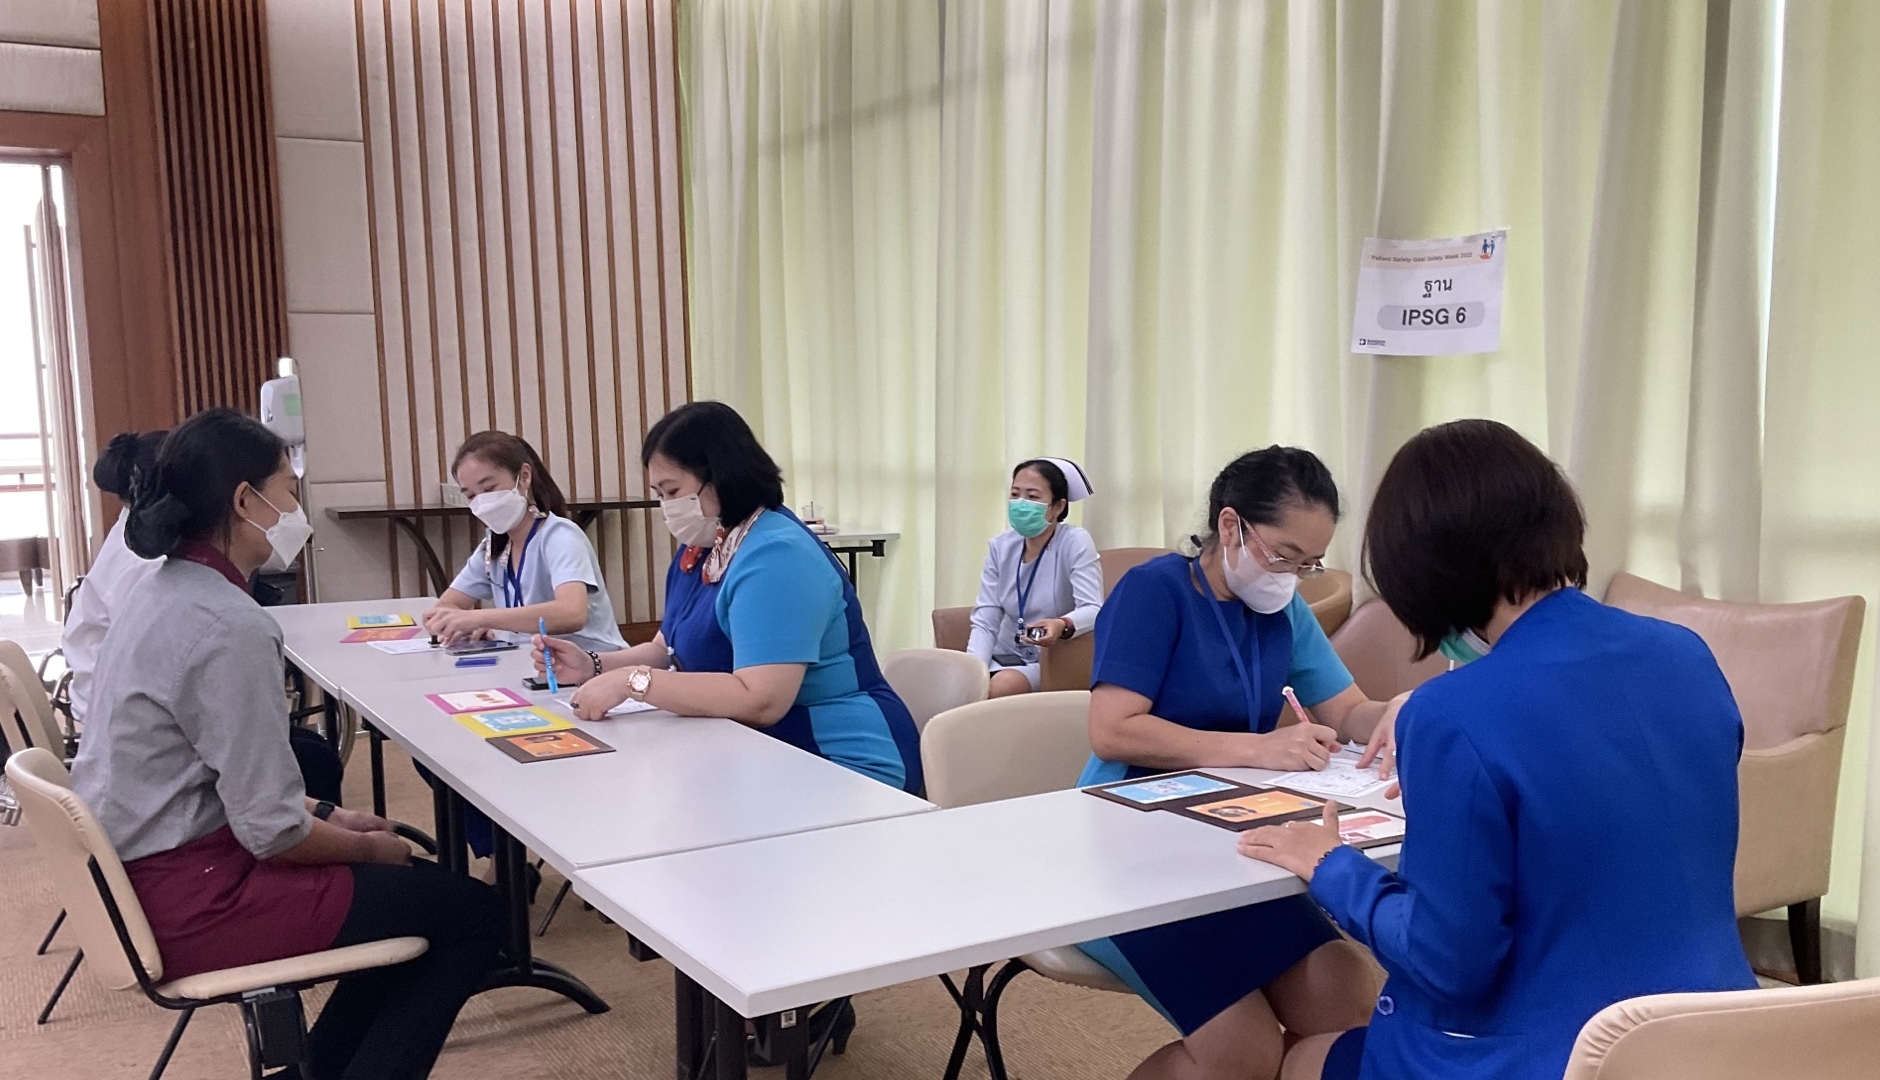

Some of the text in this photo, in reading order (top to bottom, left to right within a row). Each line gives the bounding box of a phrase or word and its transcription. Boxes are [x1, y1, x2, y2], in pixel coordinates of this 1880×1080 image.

[1422, 278, 1453, 298] ฐาน
[1401, 306, 1467, 326] IPSG 6
